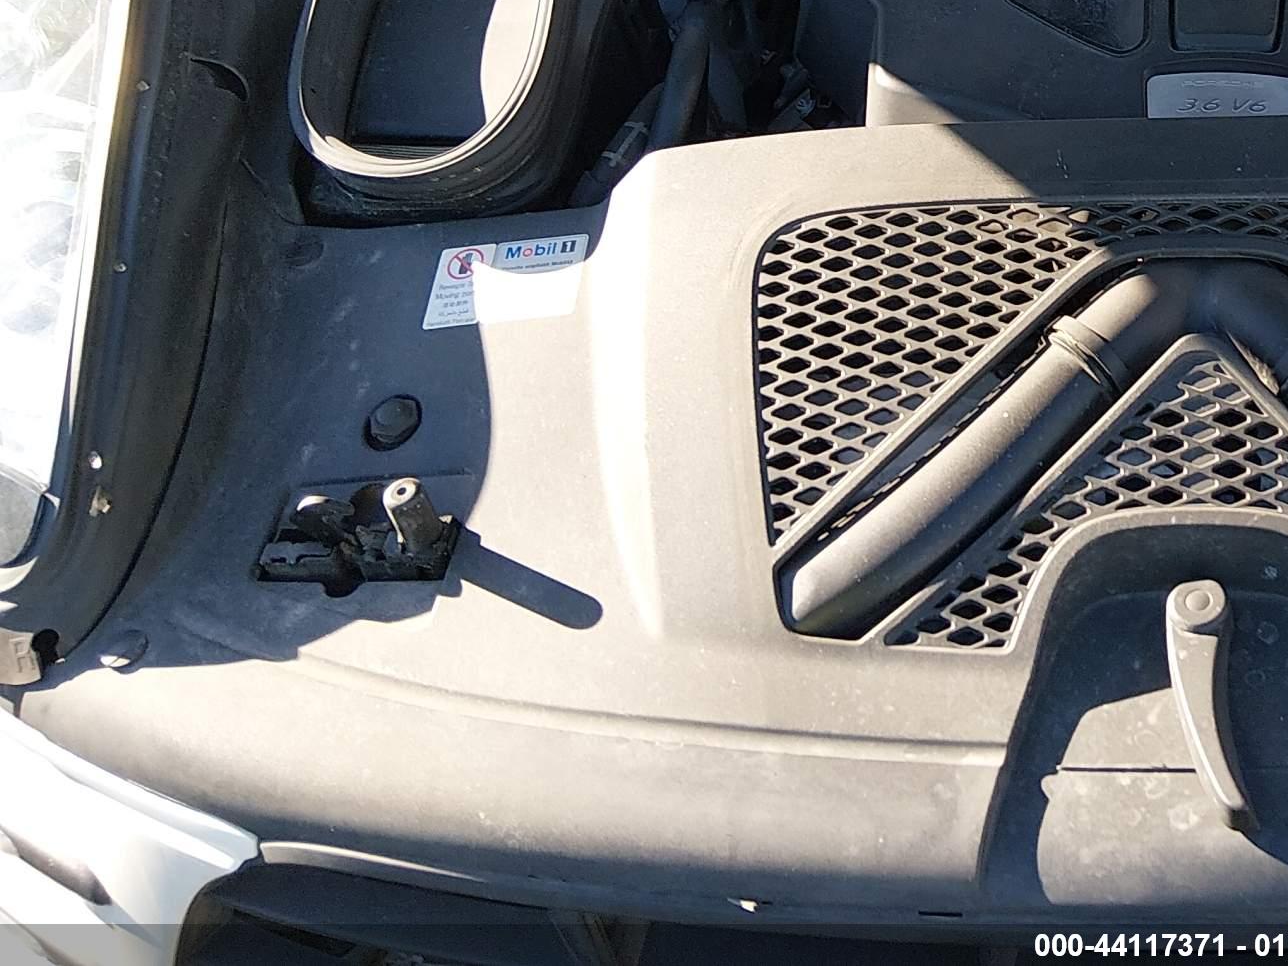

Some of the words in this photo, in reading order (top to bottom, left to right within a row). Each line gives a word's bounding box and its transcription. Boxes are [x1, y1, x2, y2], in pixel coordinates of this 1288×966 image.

[1176, 98, 1221, 113] 3.6
[1231, 98, 1268, 113] V6
[505, 241, 557, 259] Mobil
[561, 240, 575, 253] 1
